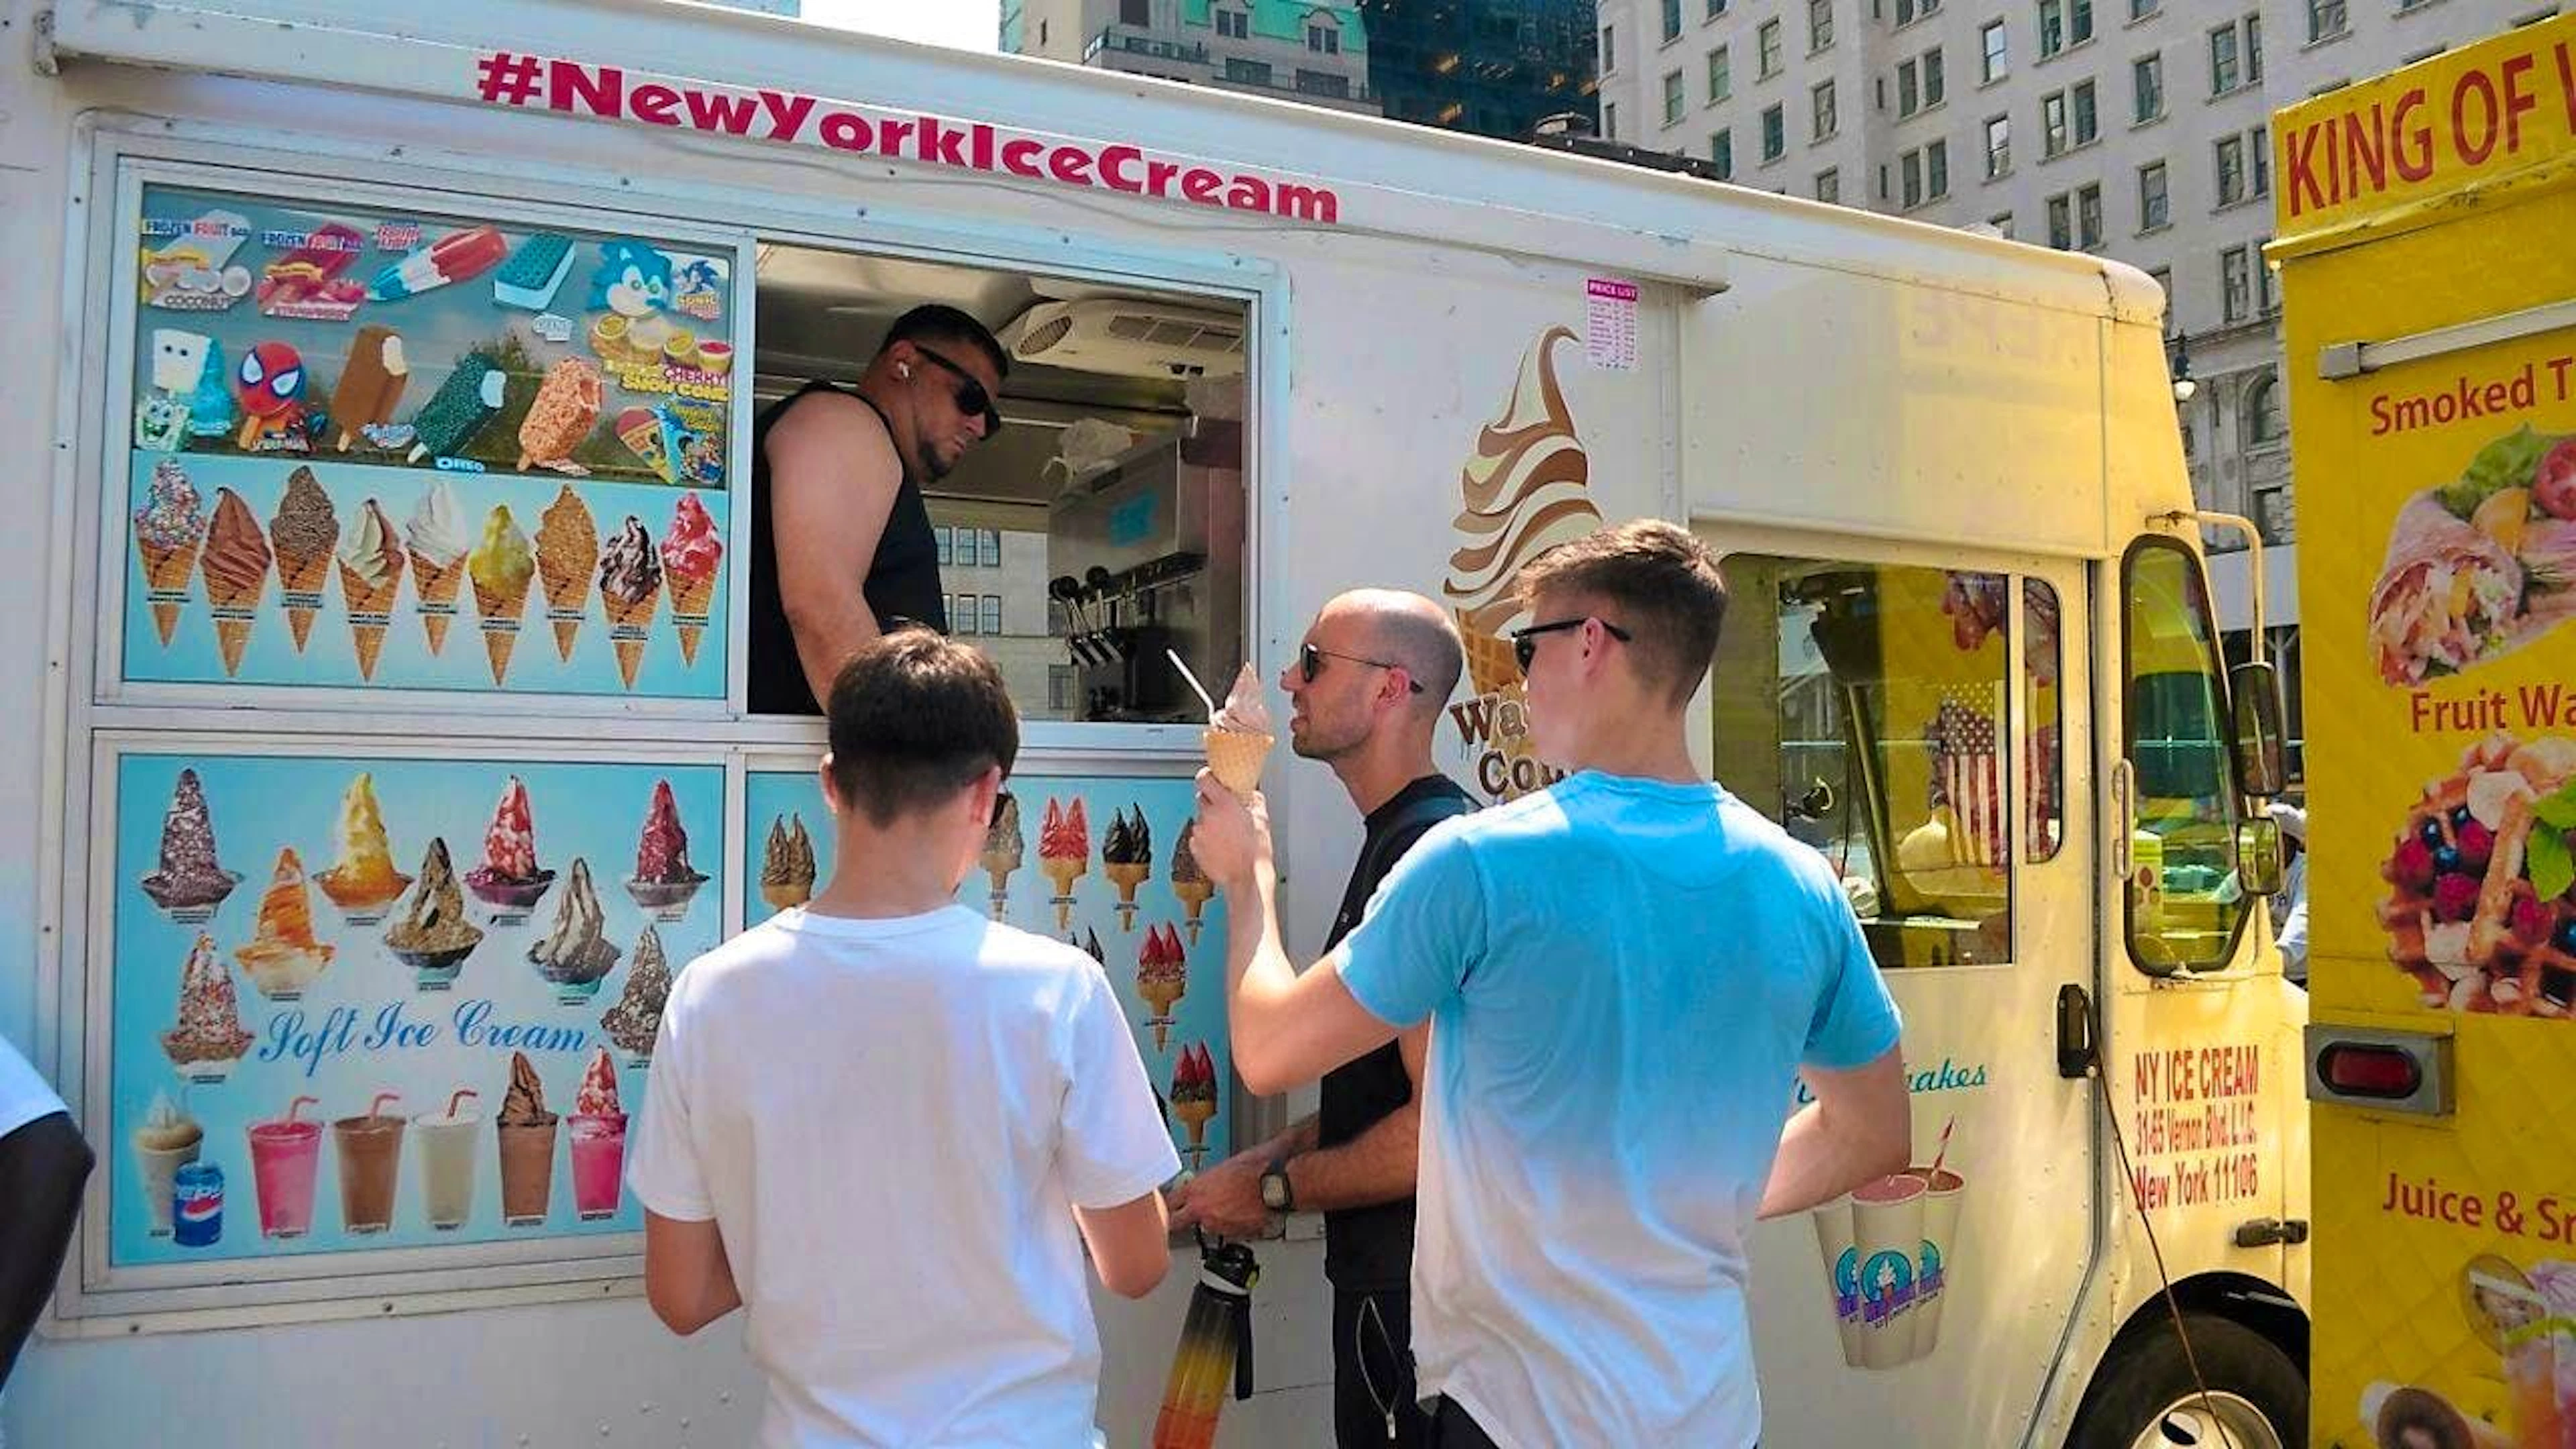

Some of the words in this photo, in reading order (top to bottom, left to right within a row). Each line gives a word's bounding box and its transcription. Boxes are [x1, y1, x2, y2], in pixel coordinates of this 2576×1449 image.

[476, 50, 1338, 223] #NewYorkIceCream
[2286, 89, 2434, 218] KING
[2451, 52, 2536, 166] OF
[1589, 282, 1616, 296] PRICE
[1617, 286, 1636, 300] LIST
[2371, 363, 2536, 435] Smoked
[1449, 691, 1527, 745] Wa
[2412, 688, 2507, 733] Fruit
[260, 1006, 358, 1077] Soft
[364, 1001, 435, 1050] Ice
[453, 999, 587, 1052] Cream
[2135, 1053, 2159, 1104] NY
[2167, 1050, 2194, 1102] ICE
[2199, 1044, 2259, 1099] CREAM
[2176, 1159, 2209, 1206] York
[2214, 1152, 2258, 1201] 11106
[2383, 1173, 2483, 1227] Juice
[2496, 1191, 2526, 1236] &
